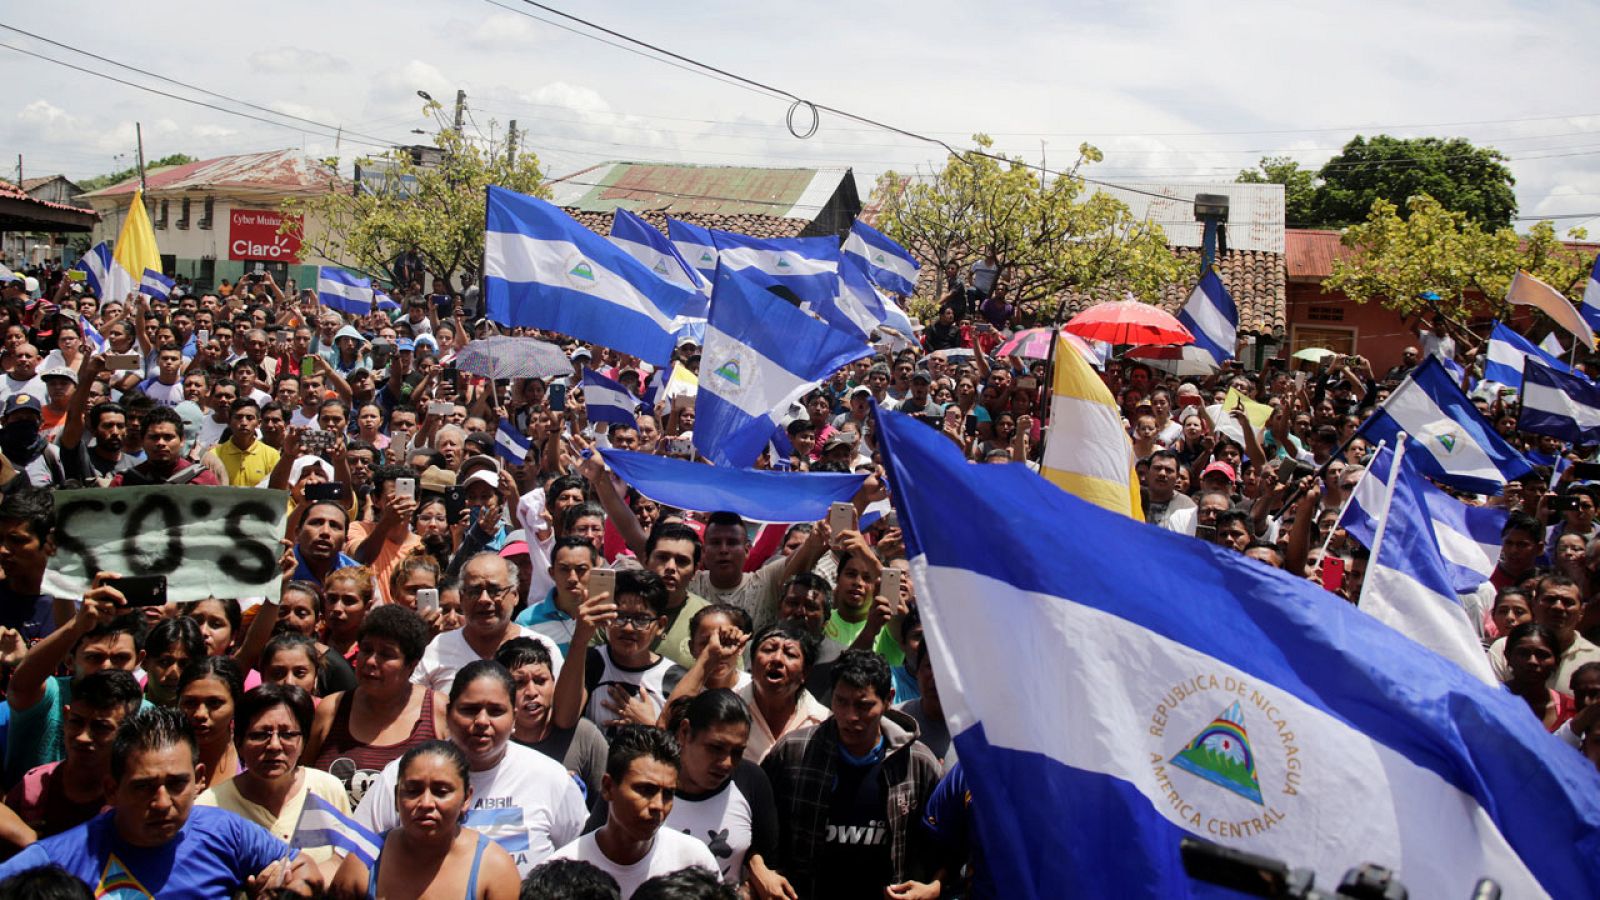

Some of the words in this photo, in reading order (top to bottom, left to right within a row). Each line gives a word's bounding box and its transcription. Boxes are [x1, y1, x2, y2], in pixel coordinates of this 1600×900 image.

[233, 213, 255, 226] Cyber
[232, 240, 281, 257] Claro
[1150, 674, 1219, 738] REPUBLICA
[1224, 676, 1247, 696] DE
[1250, 690, 1301, 796] NICARAGUA
[1150, 751, 1201, 828] AMERICA
[1207, 807, 1286, 837] CENTRAL
